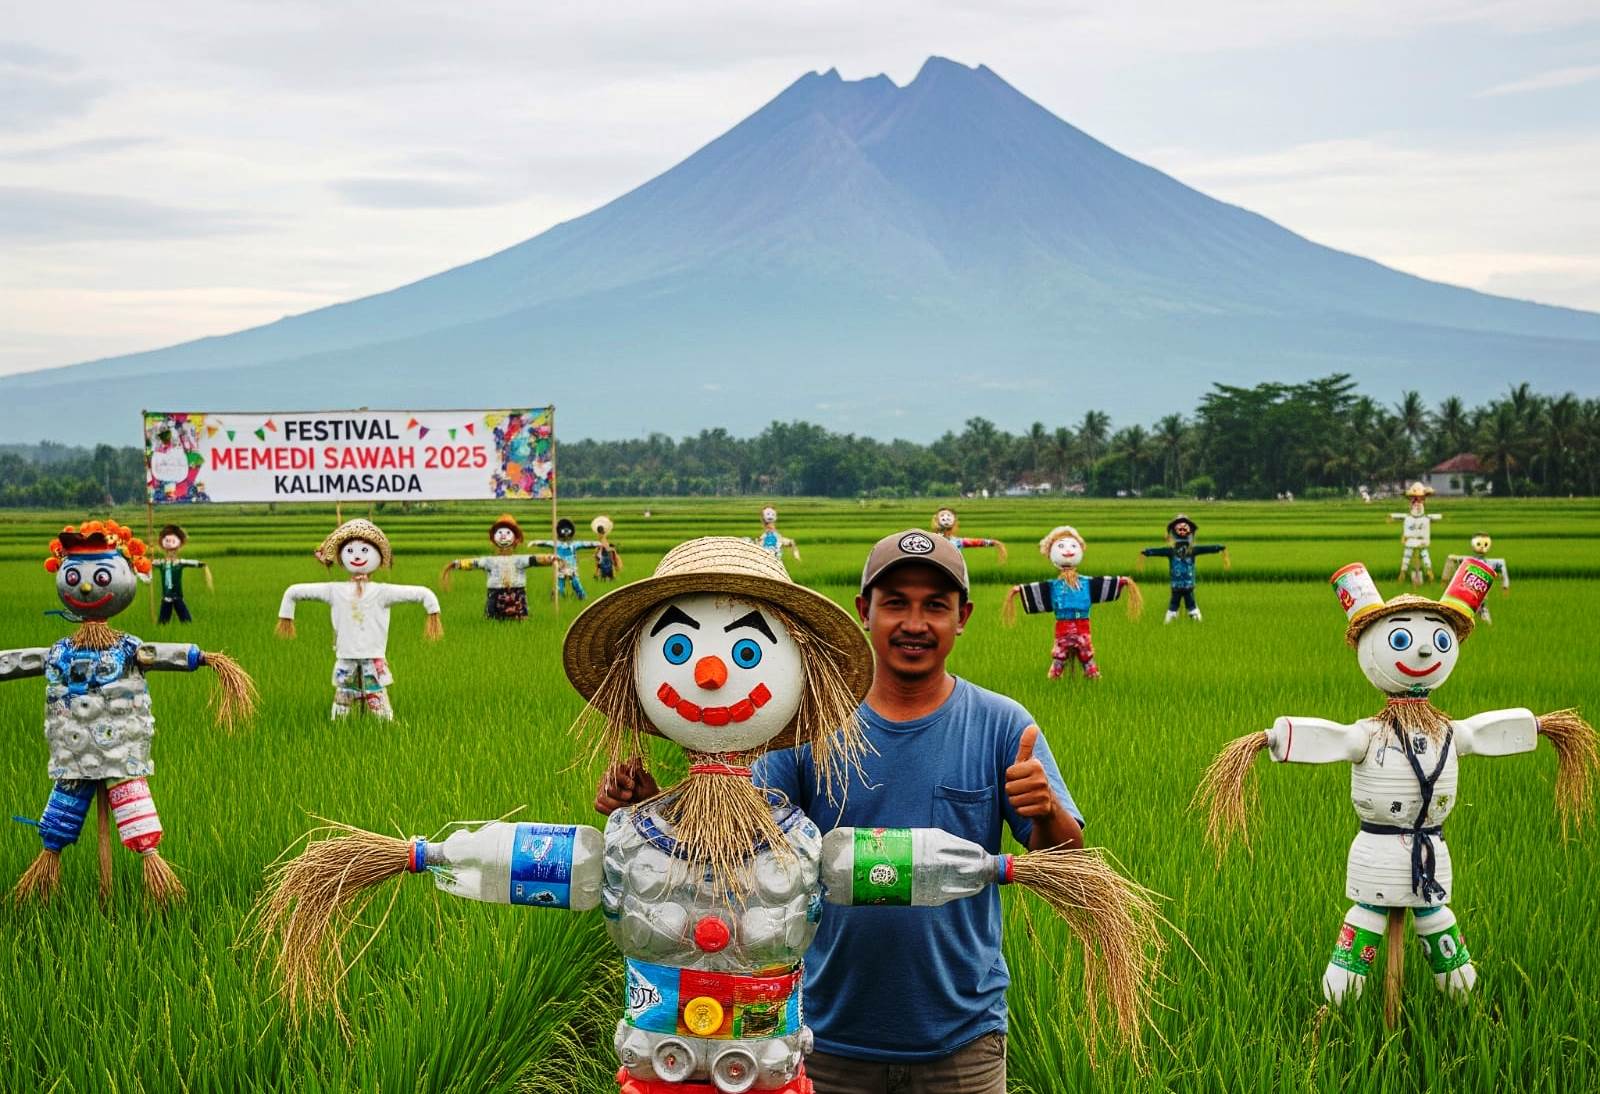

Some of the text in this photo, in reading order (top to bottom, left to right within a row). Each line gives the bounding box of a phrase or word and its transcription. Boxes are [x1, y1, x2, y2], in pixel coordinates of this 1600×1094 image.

[285, 420, 399, 441] FESTIVAL
[211, 447, 315, 470] MEMEDI
[324, 447, 415, 470] SAWAH
[425, 446, 487, 469] 2025
[274, 474, 422, 494] KALIMASADA
